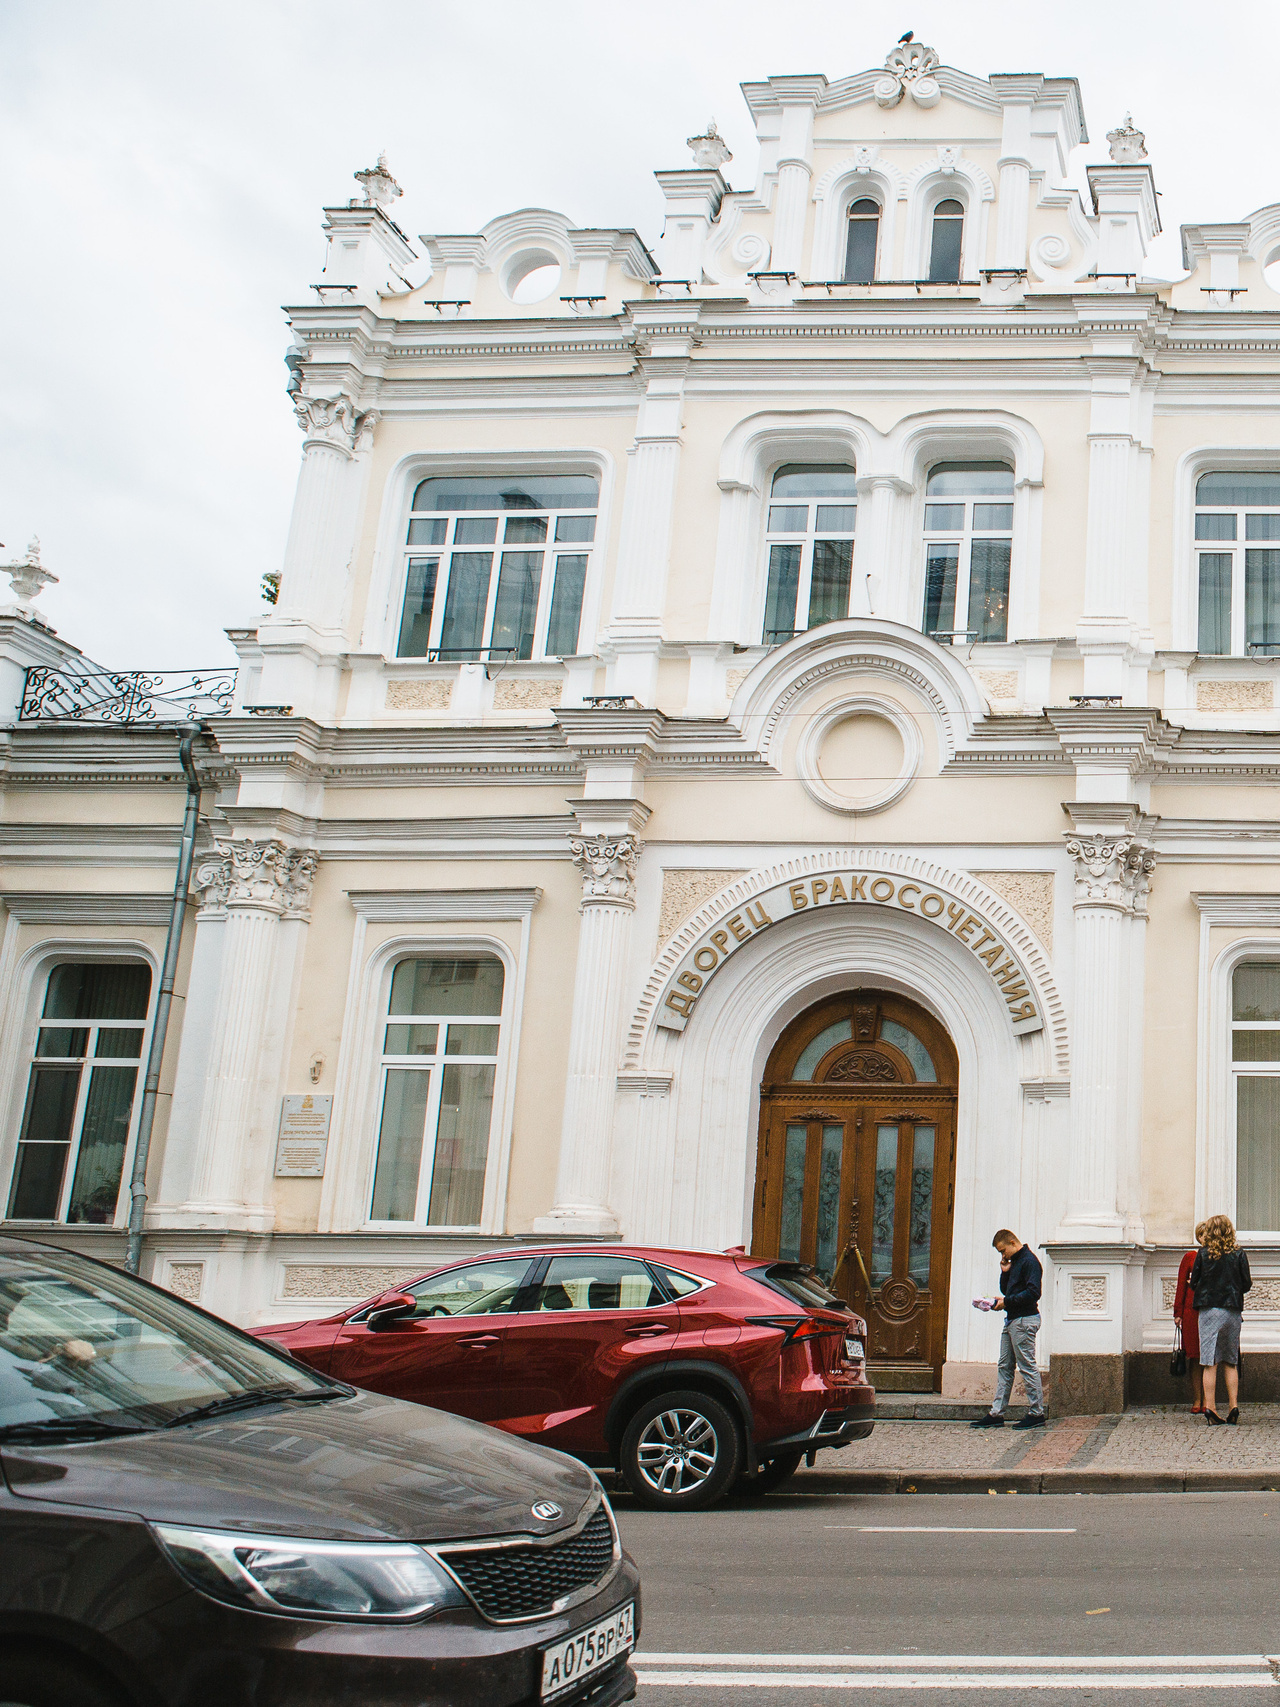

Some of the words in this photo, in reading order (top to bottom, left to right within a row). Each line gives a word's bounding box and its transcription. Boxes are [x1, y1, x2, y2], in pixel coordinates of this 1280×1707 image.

[665, 900, 773, 1018] ДВОРЕЦ
[789, 874, 1037, 1024] БРАКОСОЧЕТАНИЯ
[535, 1502, 561, 1518] KIA
[618, 1608, 632, 1638] 67
